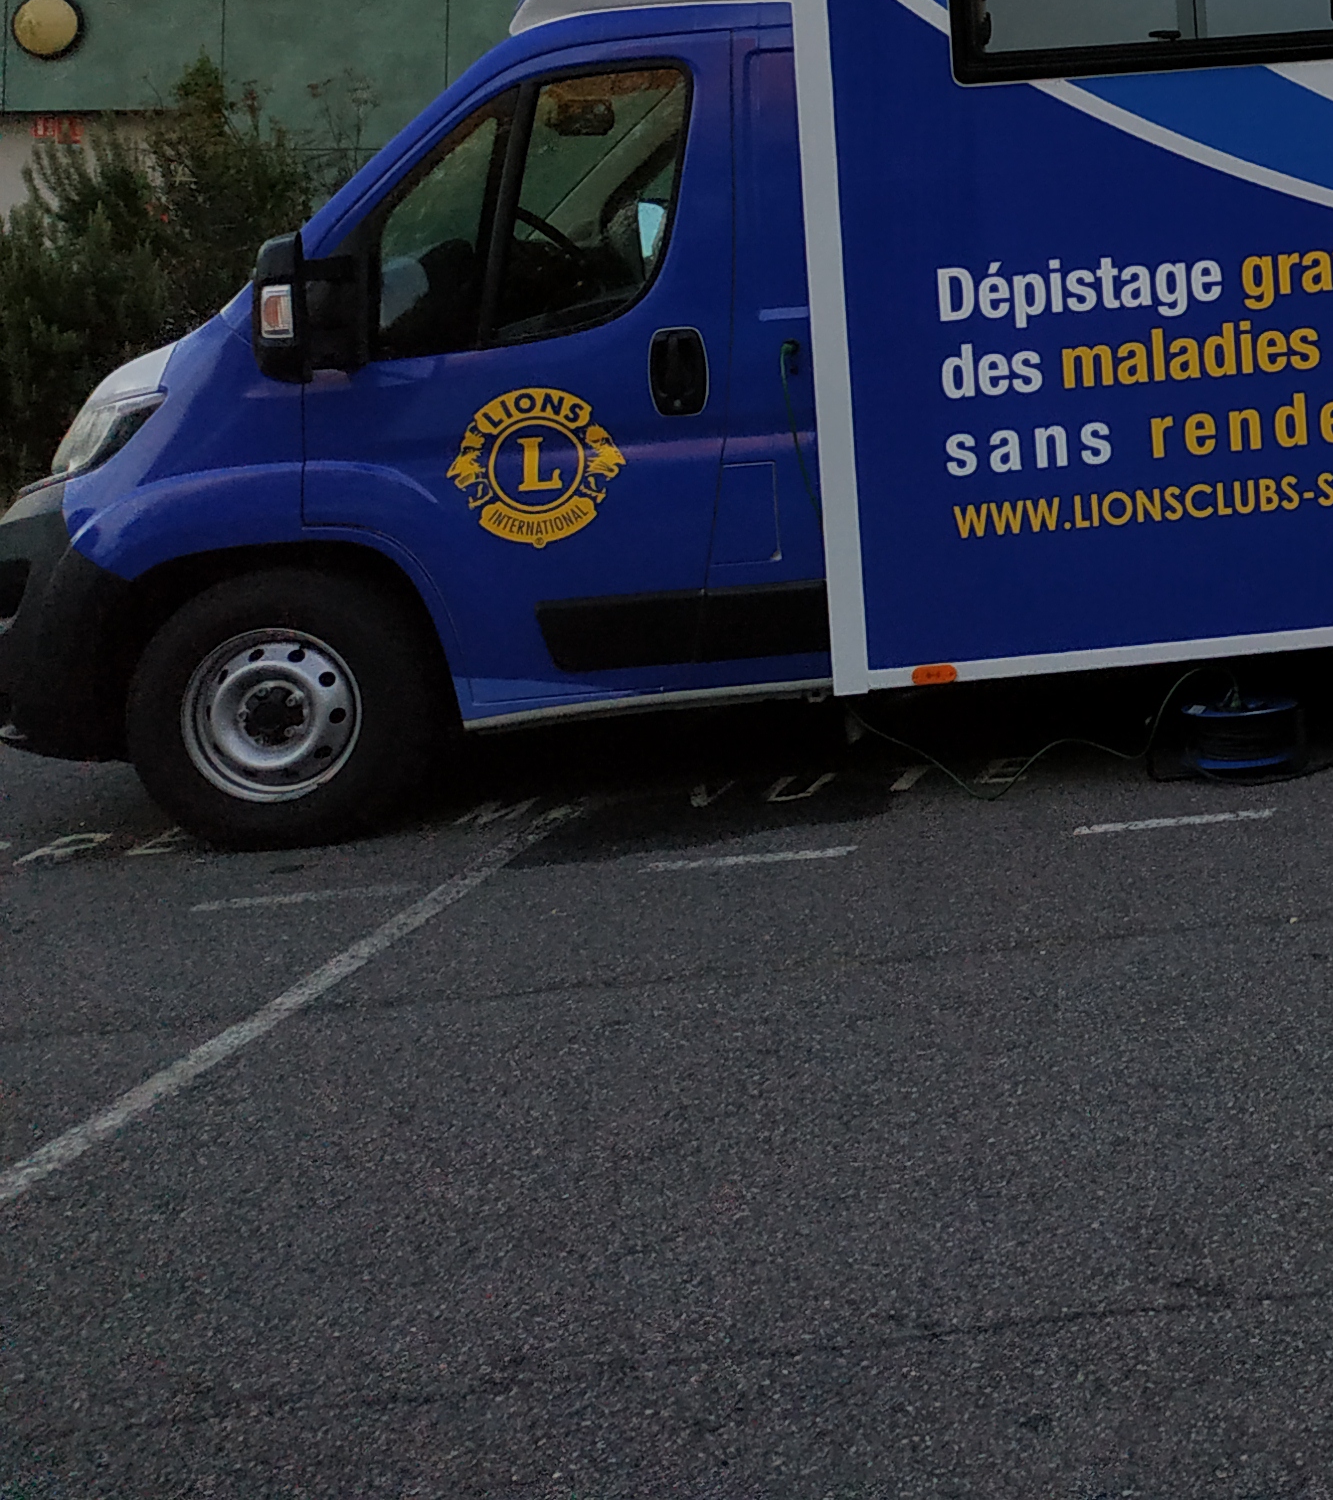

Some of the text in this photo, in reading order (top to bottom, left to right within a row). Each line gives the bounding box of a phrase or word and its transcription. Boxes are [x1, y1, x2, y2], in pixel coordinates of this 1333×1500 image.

[936, 257, 1222, 329] Dépistage
[941, 343, 1043, 399] des
[1062, 320, 1320, 388] maladies
[481, 392, 584, 429] LIONS
[516, 436, 562, 492] L
[945, 422, 1112, 477] sans
[488, 504, 589, 536] INTERNATIONAL
